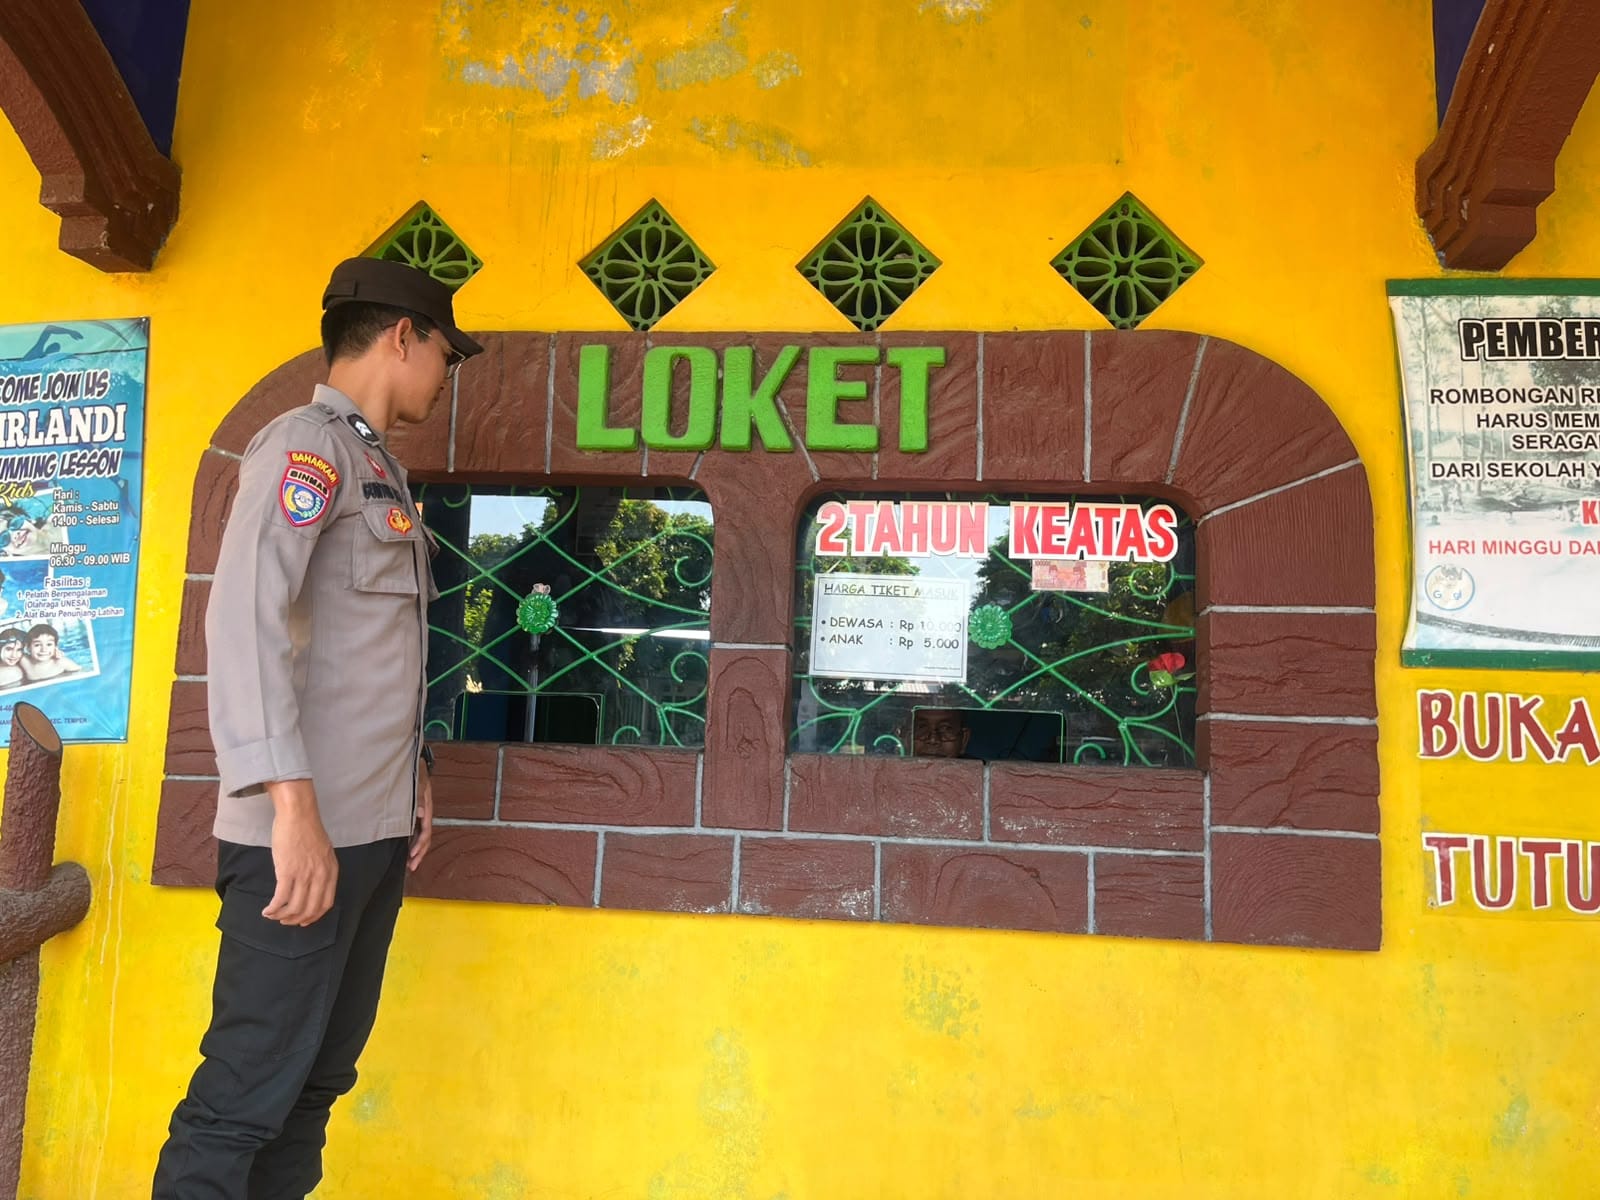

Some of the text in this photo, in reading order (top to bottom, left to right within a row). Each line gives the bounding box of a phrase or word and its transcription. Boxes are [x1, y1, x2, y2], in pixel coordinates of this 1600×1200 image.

[1458, 318, 1600, 361] PEMBER
[0, 369, 109, 404] OME JOIN US
[576, 345, 945, 453] LOKET
[1430, 388, 1600, 404] ROMBONGAN R
[1477, 413, 1600, 428] HARUS MEM
[1512, 434, 1600, 449] SERAGA
[0, 450, 121, 481] MMING LESSON
[291, 452, 338, 483] BAHARKAM
[1432, 463, 1480, 477] DARI
[1487, 463, 1585, 478] SEKOLAH
[290, 470, 328, 495] BINMAS
[53, 489, 73, 500] Hari
[53, 503, 83, 513] Kamis
[91, 501, 119, 512] Sabtu
[1582, 501, 1600, 524] K
[52, 515, 78, 527] 14.00
[86, 513, 120, 525] Selesai
[1009, 501, 1179, 562] KEATAS
[50, 543, 87, 555] Minggu
[1429, 541, 1600, 555] HARI MINGGU DA
[50, 556, 76, 567] 06.30
[83, 555, 109, 566] 09.00
[111, 552, 131, 564] WIB
[45, 577, 84, 587] Fasilitas
[51, 589, 106, 599] Berpengalaman
[824, 583, 865, 595] HARGA
[872, 585, 909, 597] TIKET
[39, 610, 56, 618] Baru
[830, 617, 883, 629] DEWASA
[899, 619, 914, 632] Rp
[829, 634, 863, 645] ANAK
[898, 636, 913, 649] Rp
[923, 638, 959, 649] 5.000
[1417, 689, 1600, 766] BUKA
[1422, 832, 1600, 913] TUTU
